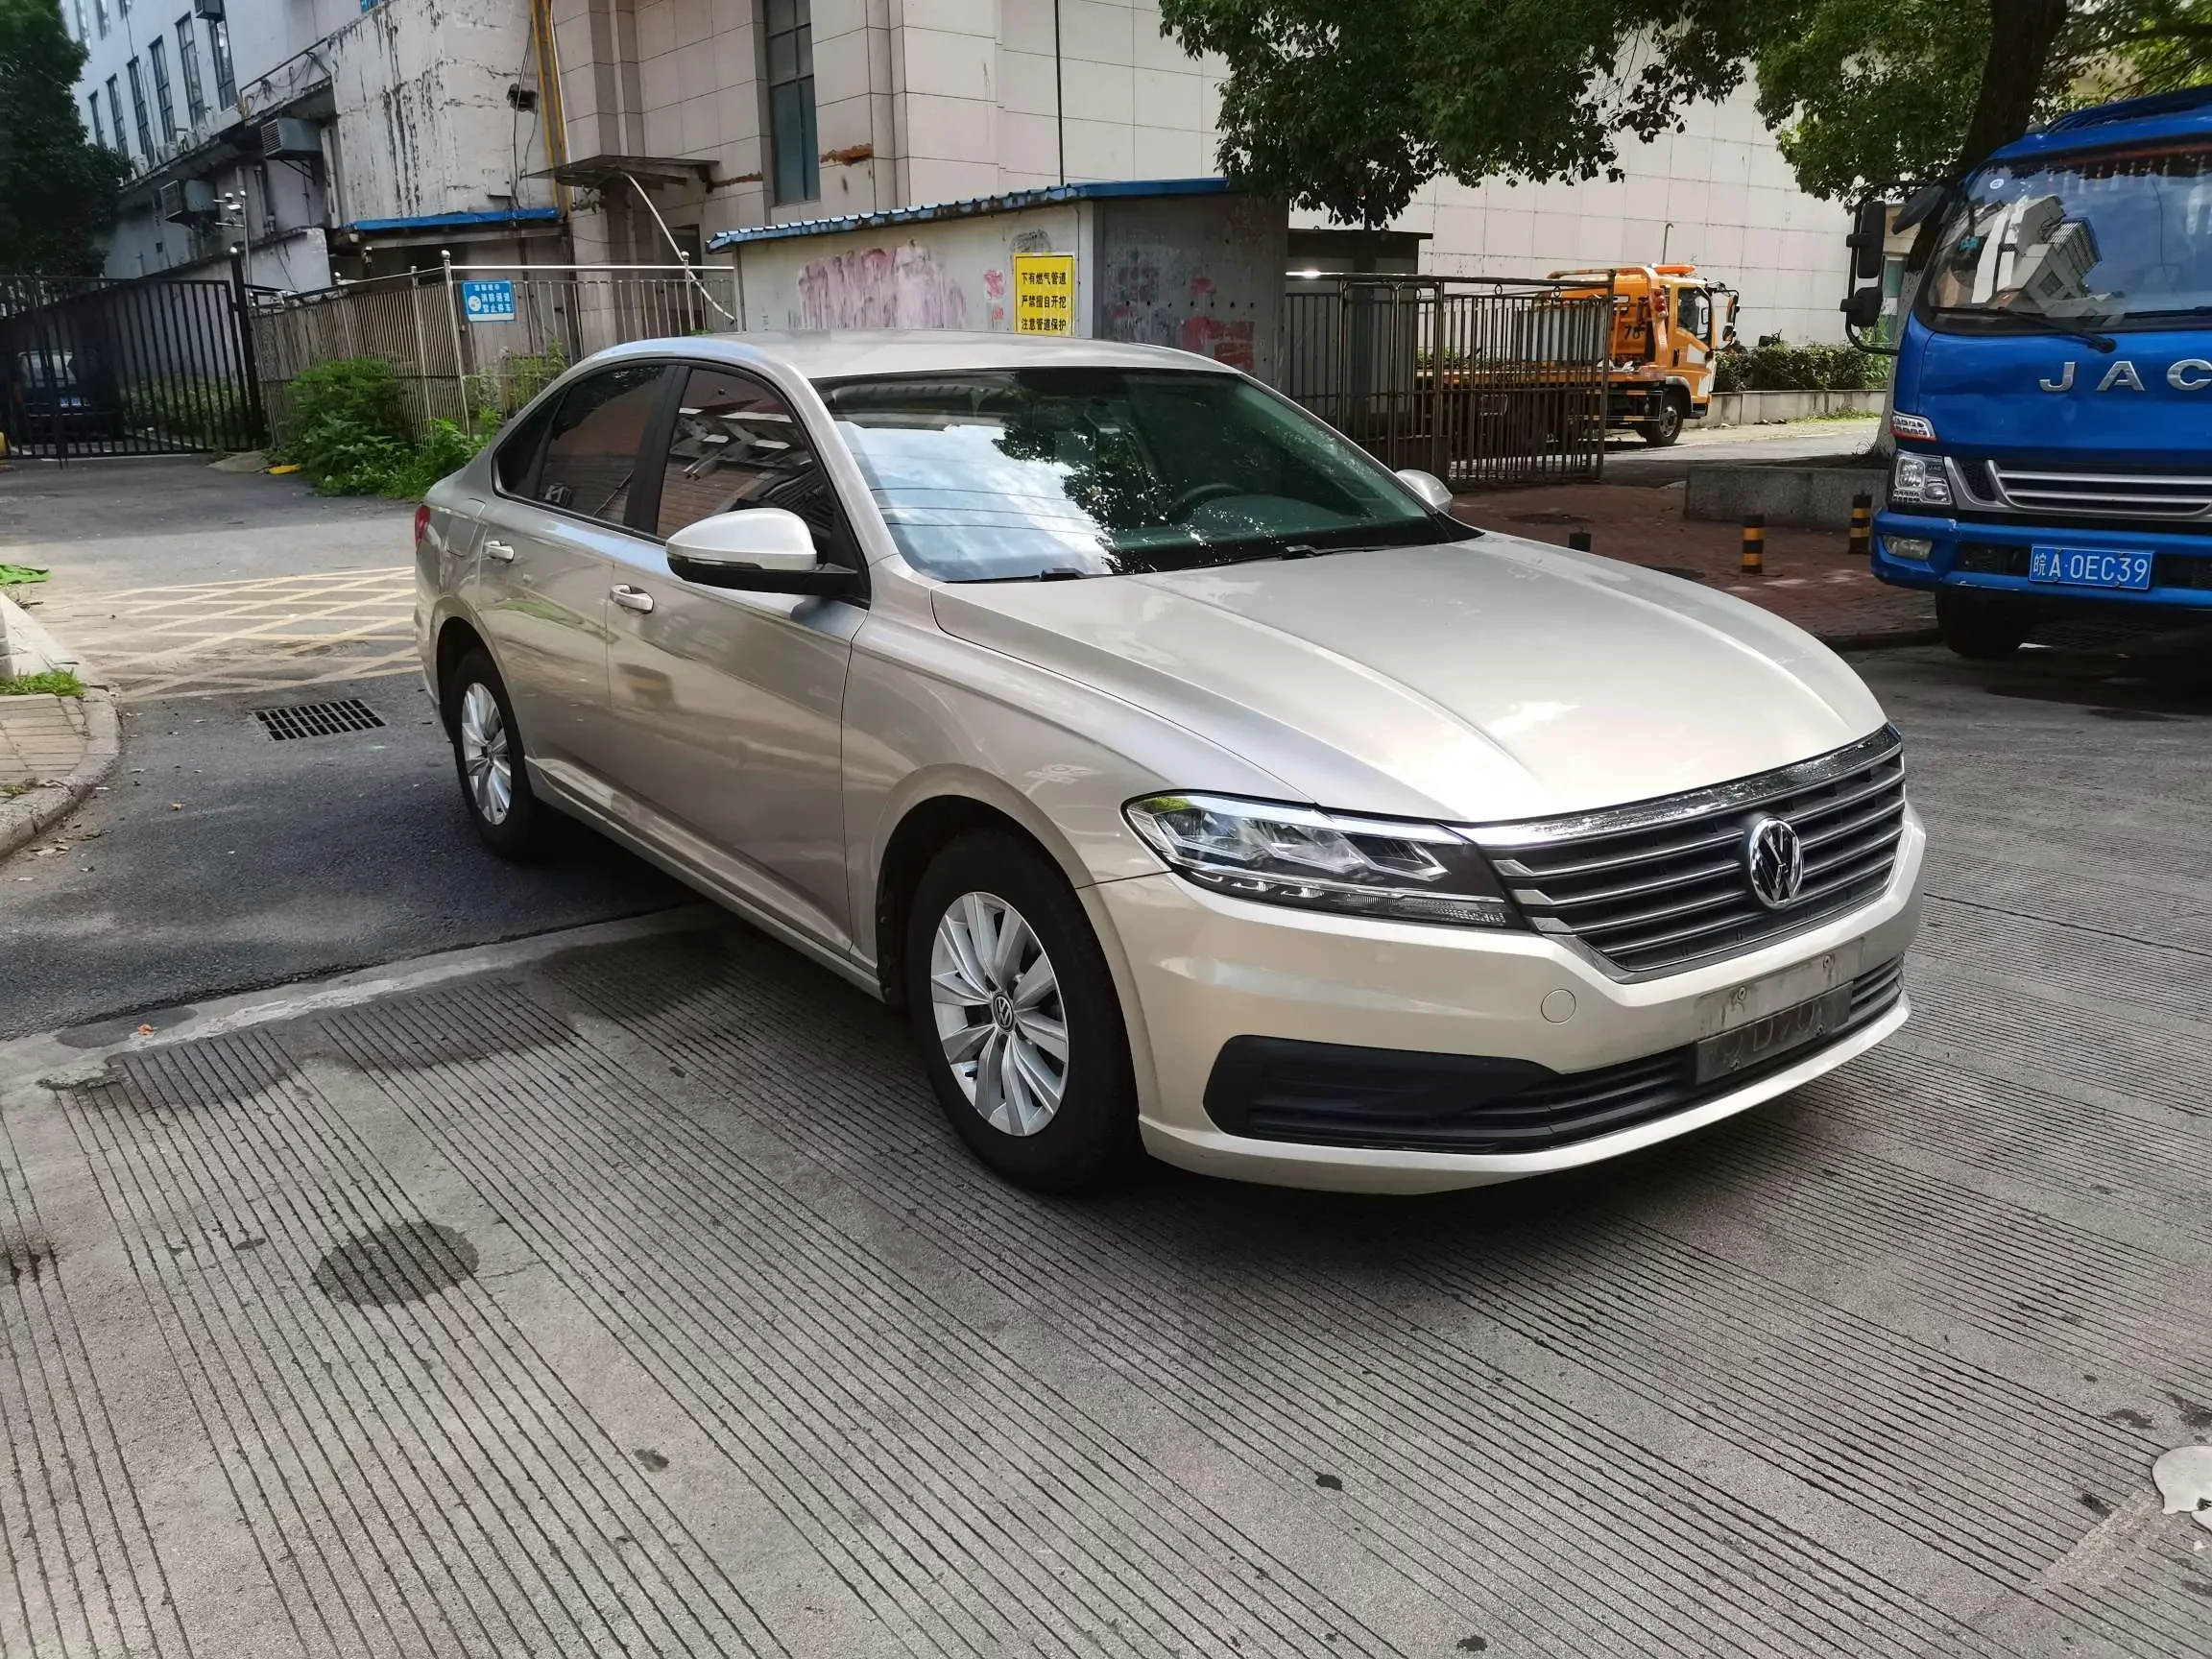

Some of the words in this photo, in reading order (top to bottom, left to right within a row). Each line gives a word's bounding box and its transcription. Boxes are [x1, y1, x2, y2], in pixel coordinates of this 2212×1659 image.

[1022, 272, 1067, 285] 下有燃气管道
[1022, 295, 1067, 308] 严禁擅自开挖
[1022, 318, 1067, 331] 注意管道保护
[2039, 358, 2212, 392] JAC
